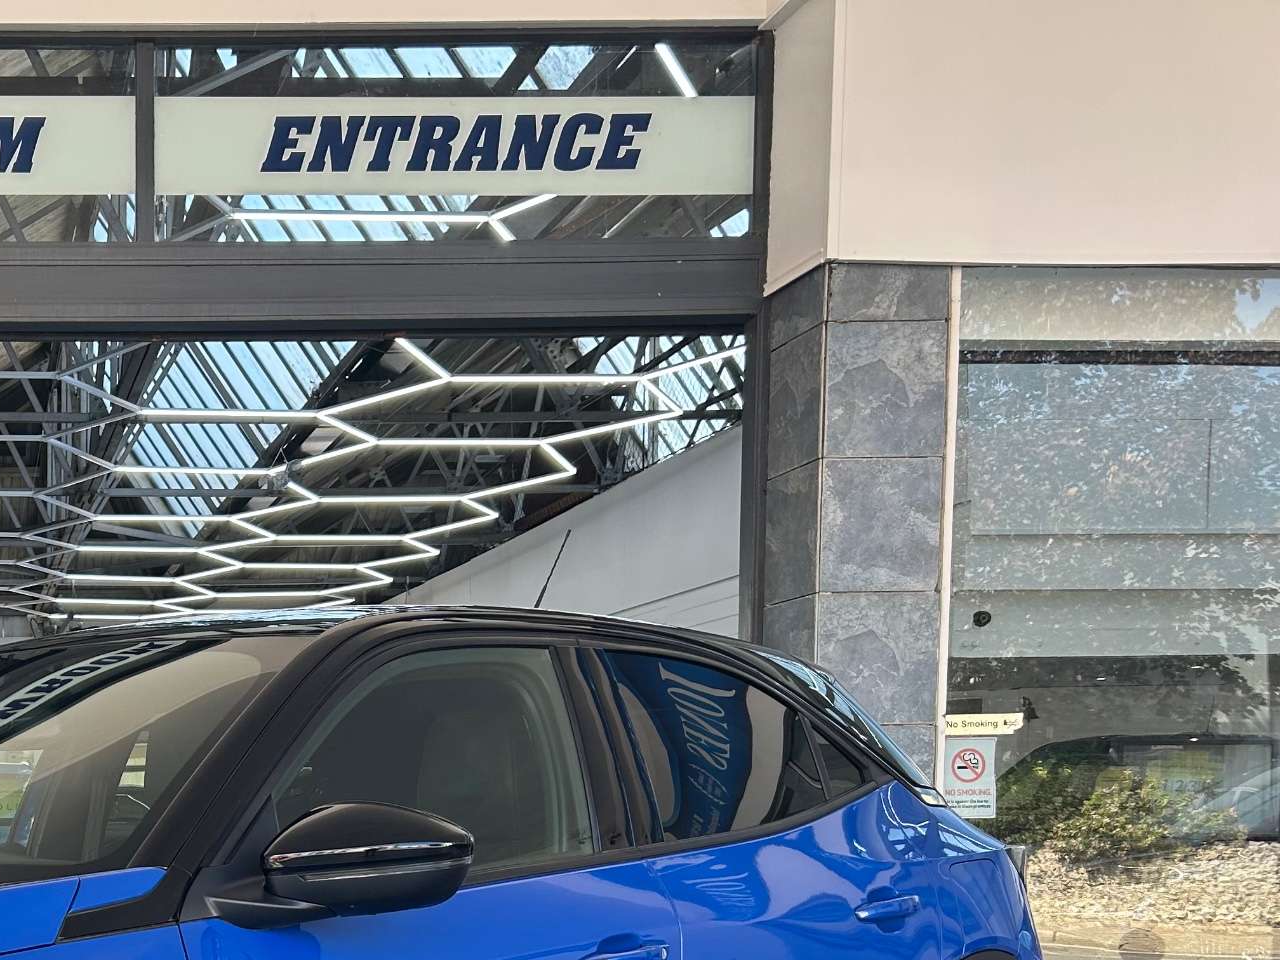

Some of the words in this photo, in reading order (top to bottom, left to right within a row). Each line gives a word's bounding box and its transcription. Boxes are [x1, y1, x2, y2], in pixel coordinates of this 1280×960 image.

[260, 112, 653, 173] ENTRANCE
[946, 720, 958, 728] No
[961, 719, 998, 729] Smoking
